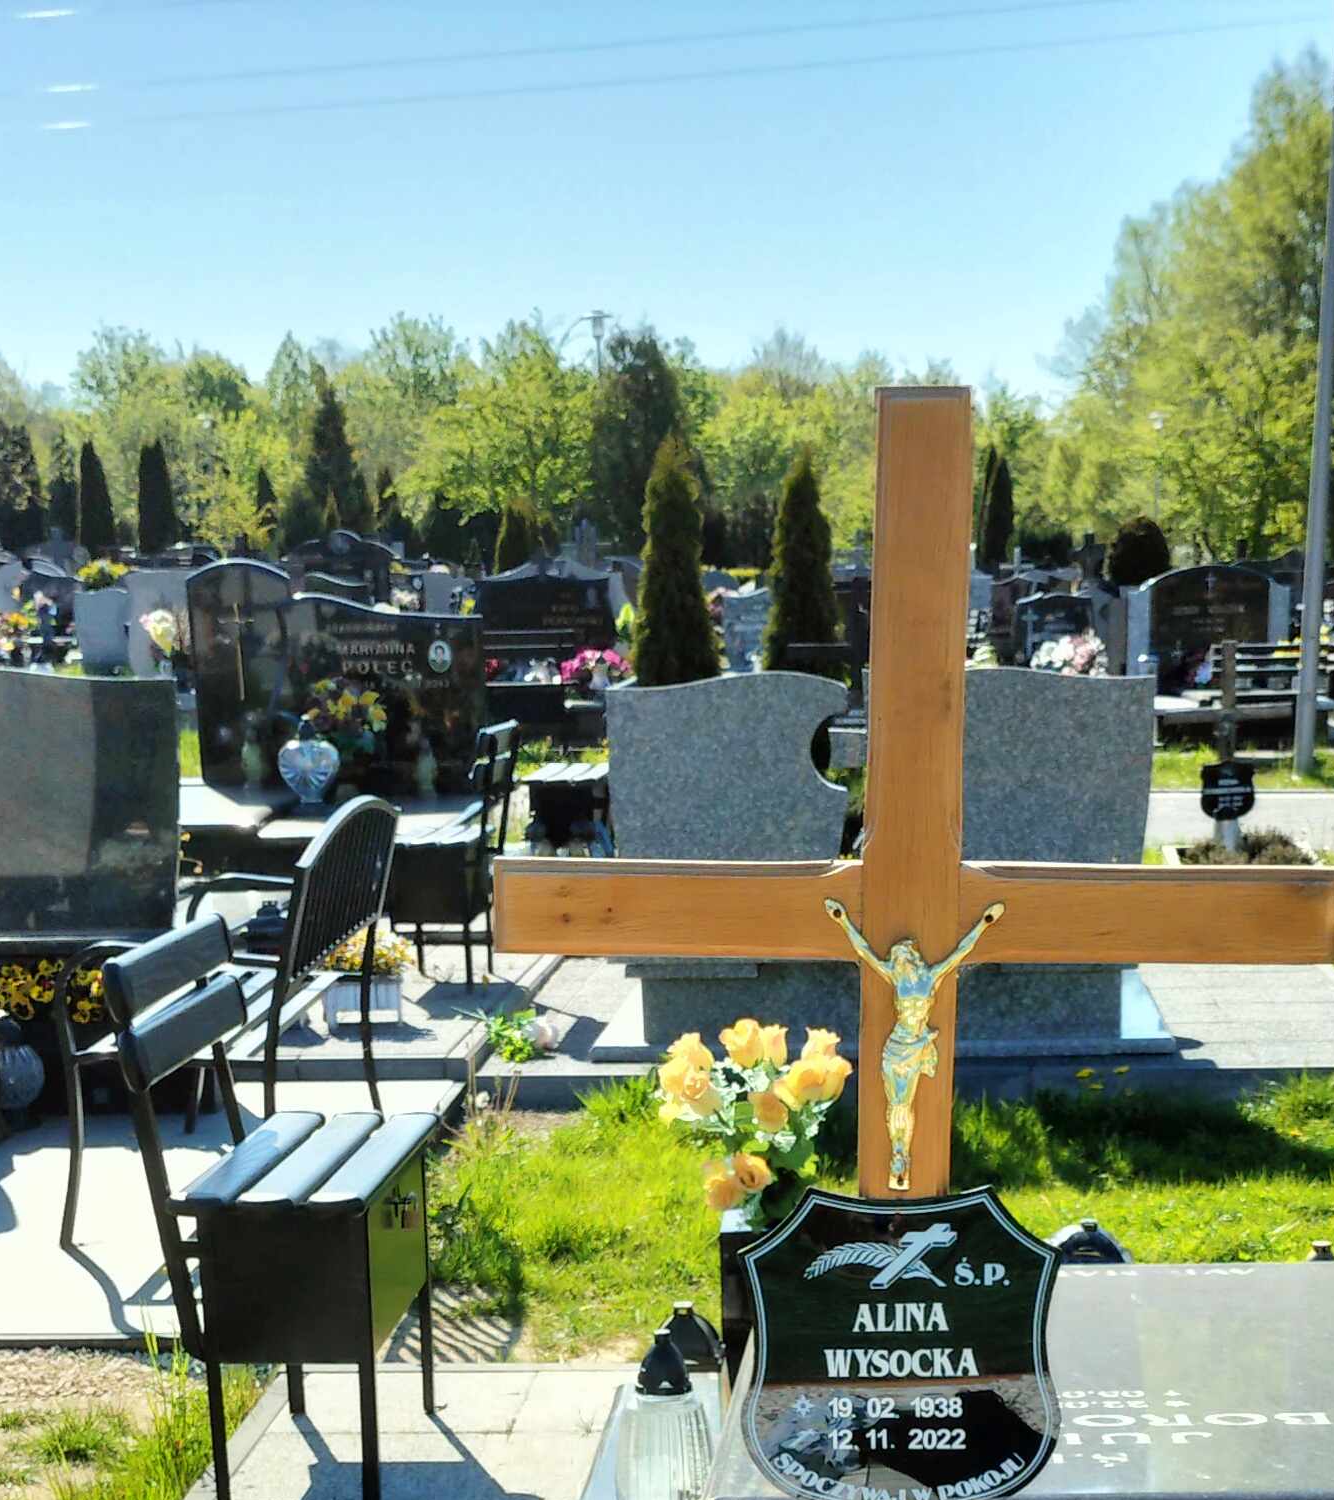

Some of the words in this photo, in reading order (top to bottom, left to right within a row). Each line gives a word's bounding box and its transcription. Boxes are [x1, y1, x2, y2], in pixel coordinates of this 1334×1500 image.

[954, 1256, 1011, 1287] Ś.P.
[852, 1302, 950, 1333] ALINA
[823, 1347, 980, 1378] WYSOCKA
[911, 1396, 963, 1419] 1938
[1058, 1411, 1332, 1428] BORO
[908, 1428, 967, 1451] 2022
